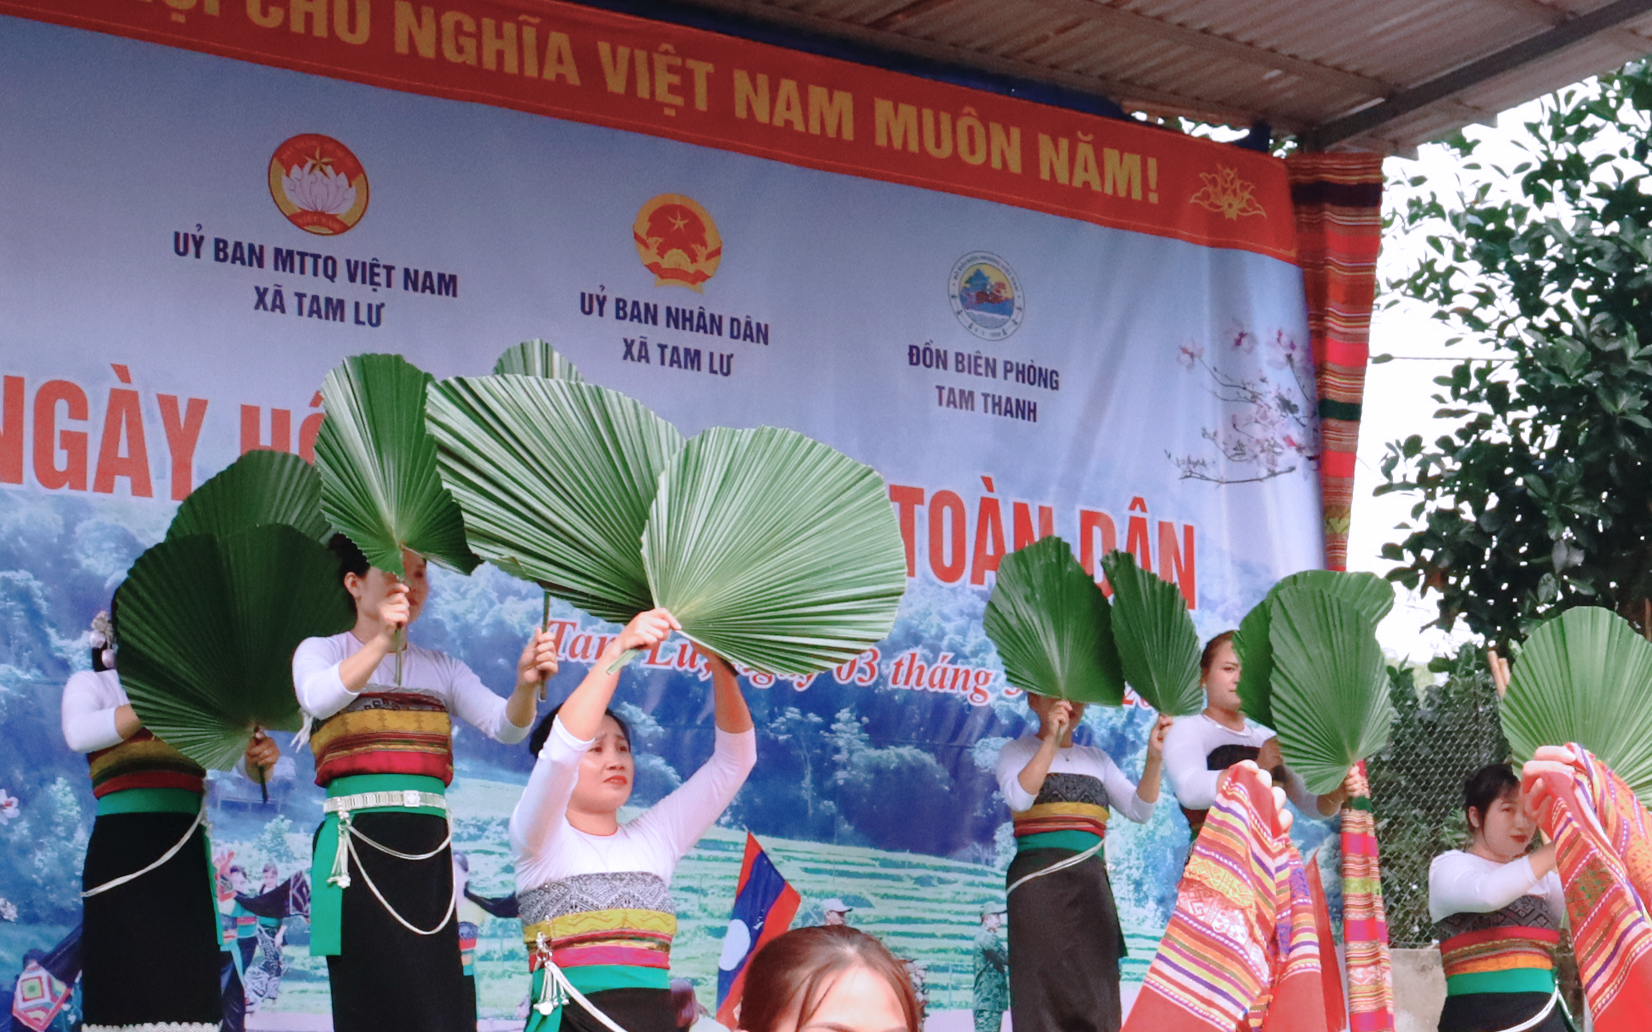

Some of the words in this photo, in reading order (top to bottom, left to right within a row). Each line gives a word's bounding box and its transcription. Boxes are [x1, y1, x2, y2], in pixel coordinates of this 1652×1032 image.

[394, 0, 581, 86] NGHĨA
[597, 43, 714, 117] VIỆT
[733, 69, 854, 141] NAM
[874, 97, 1022, 174] MUÔN
[1038, 131, 1159, 204] NĂM!
[173, 224, 205, 259] UỶ
[214, 237, 265, 269] BAN
[273, 247, 338, 282] MTTQ
[345, 257, 396, 292] VIỆT
[403, 267, 458, 298] NAM
[253, 283, 286, 314] XÃ
[294, 292, 346, 323] TAM
[354, 301, 386, 328] LƯ
[580, 284, 607, 317] UỶ
[615, 297, 658, 327] BAN
[665, 305, 723, 337] NHÂN
[729, 315, 769, 346] DÂN
[622, 335, 651, 365] XÃ
[657, 342, 701, 372] TAM
[708, 351, 734, 377] LƯ
[908, 340, 948, 371] ĐỒN
[955, 350, 997, 379] BIÊN
[1003, 359, 1060, 391] PHÒNG
[935, 385, 975, 412] TAM
[980, 392, 1038, 423] THANH
[890, 652, 993, 704] tháng
